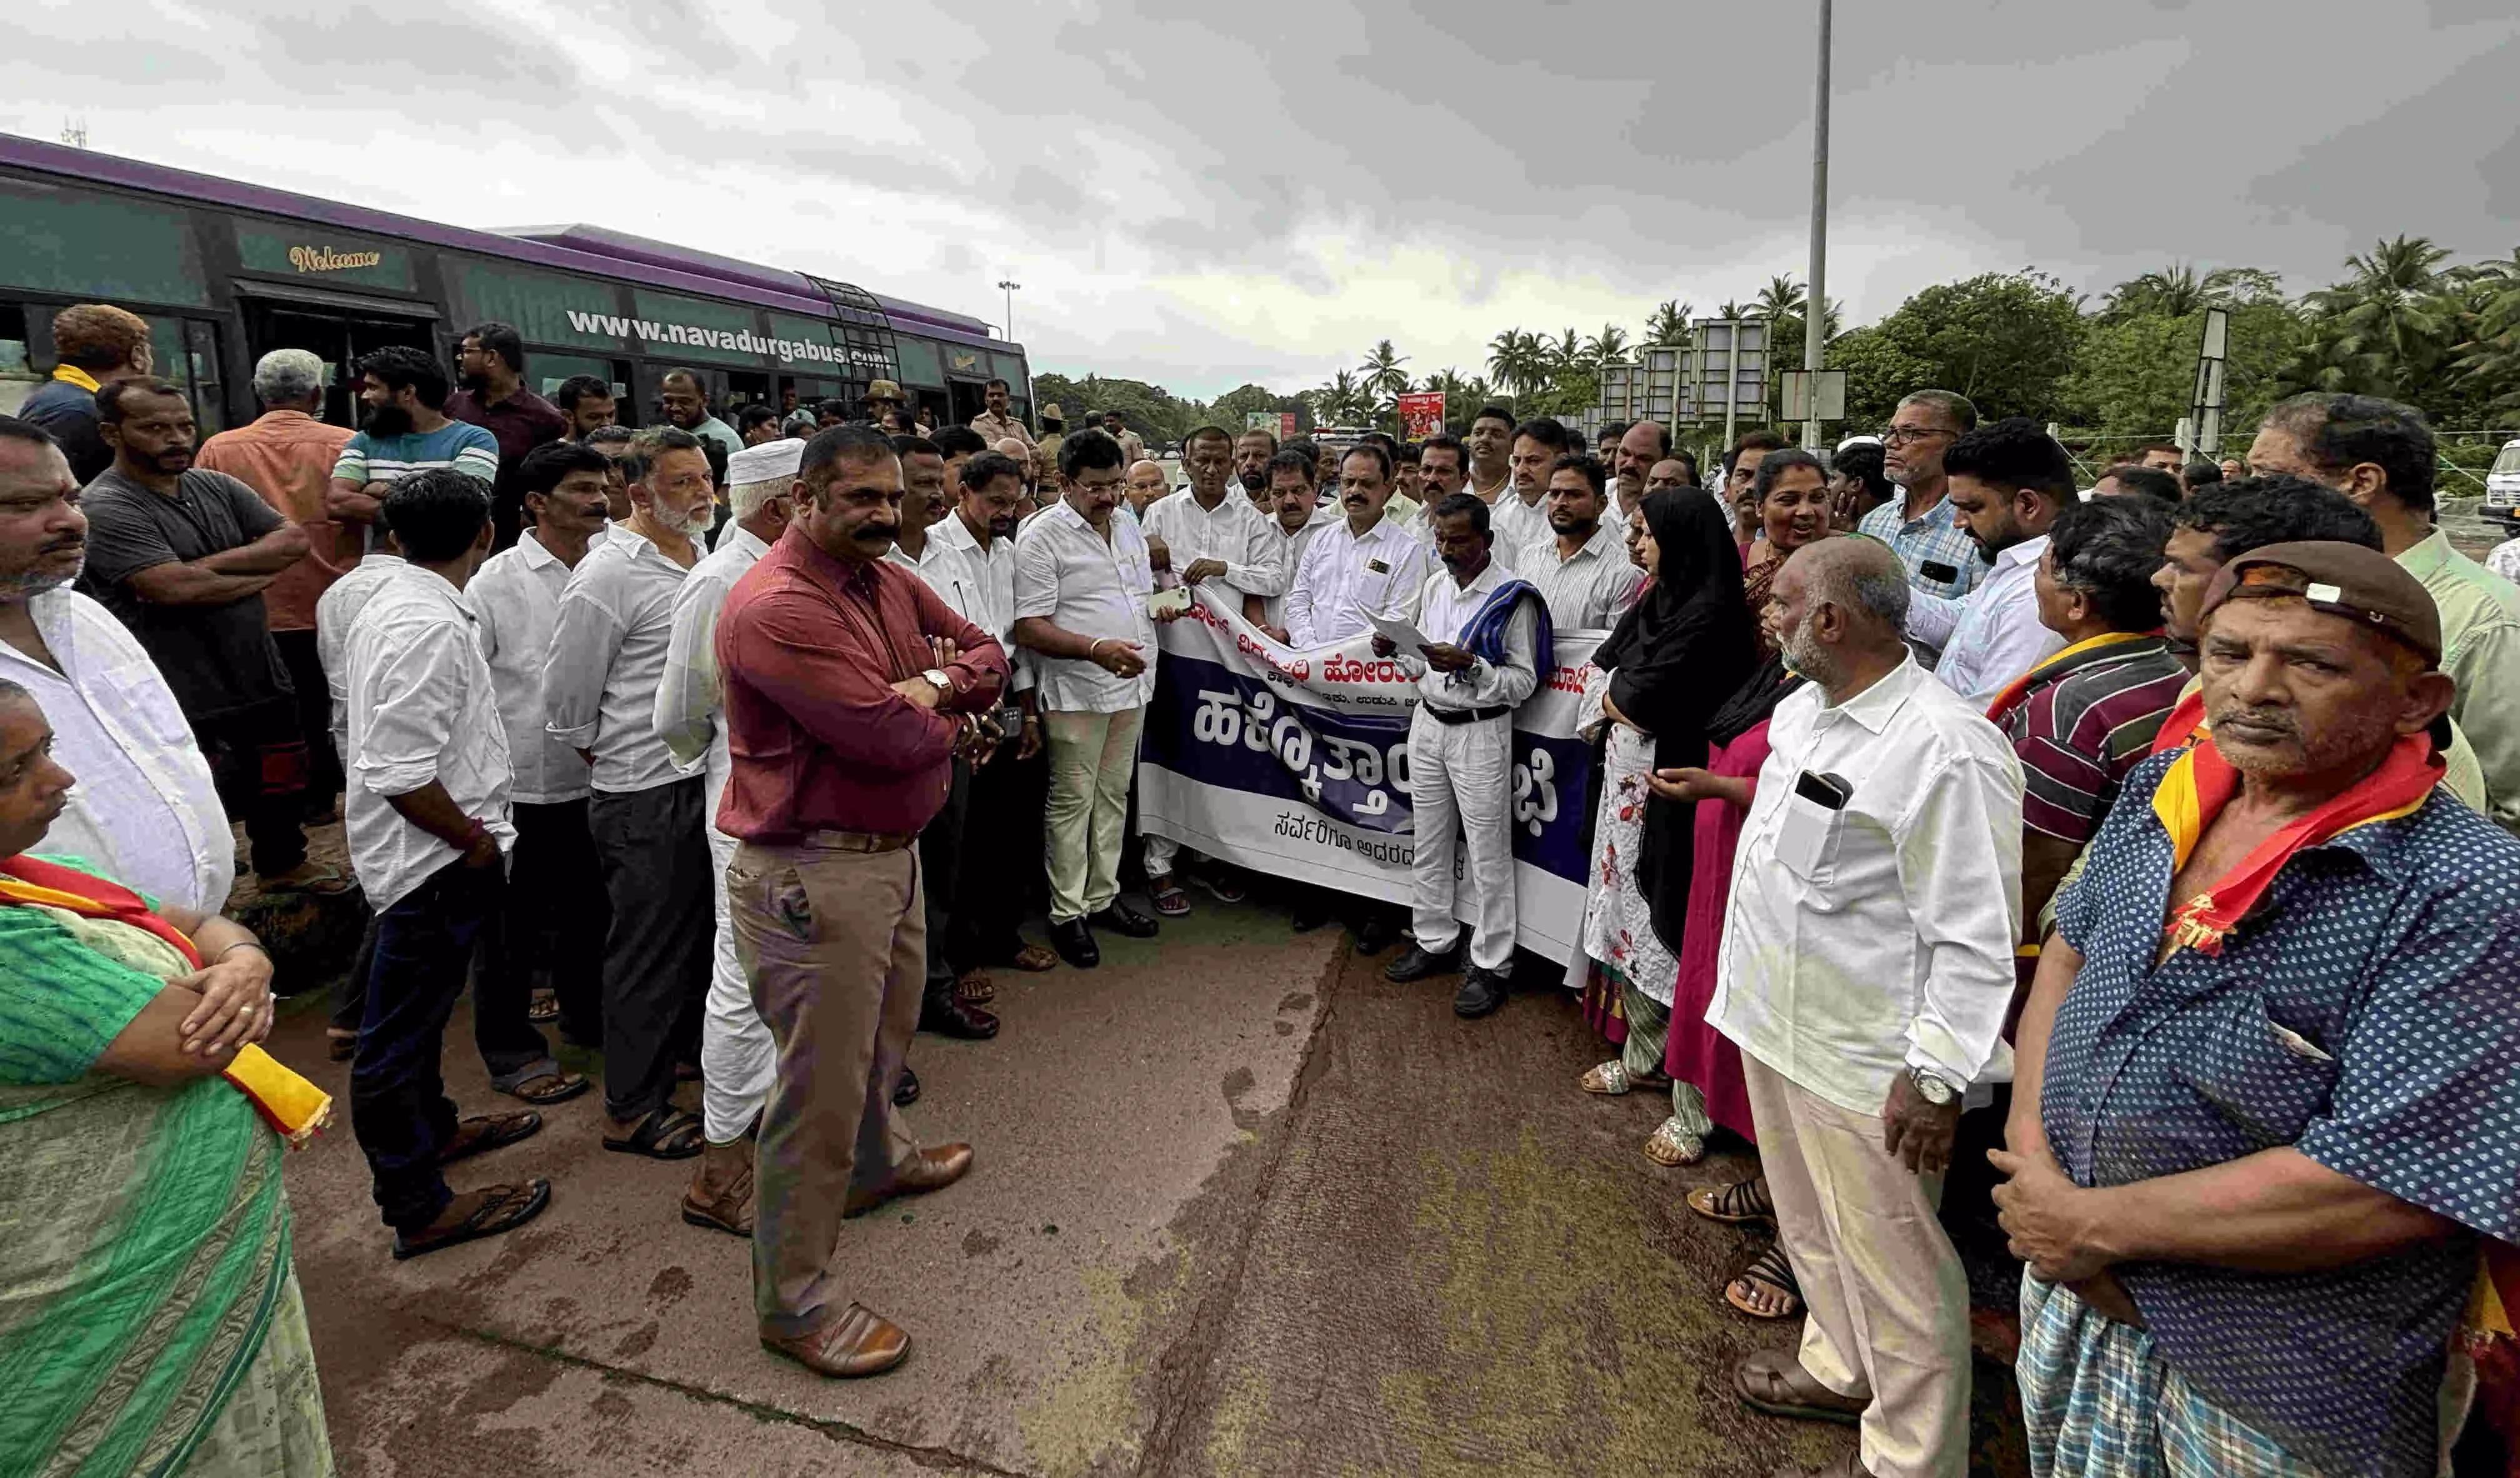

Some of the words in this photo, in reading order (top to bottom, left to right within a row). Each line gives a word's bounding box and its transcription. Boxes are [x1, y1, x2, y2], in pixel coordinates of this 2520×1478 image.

[289, 245, 380, 273] Welcome
[566, 310, 891, 370] www.navadurgabus.com
[1274, 811, 1352, 851] ಸರ್ವರಿಗೂ
